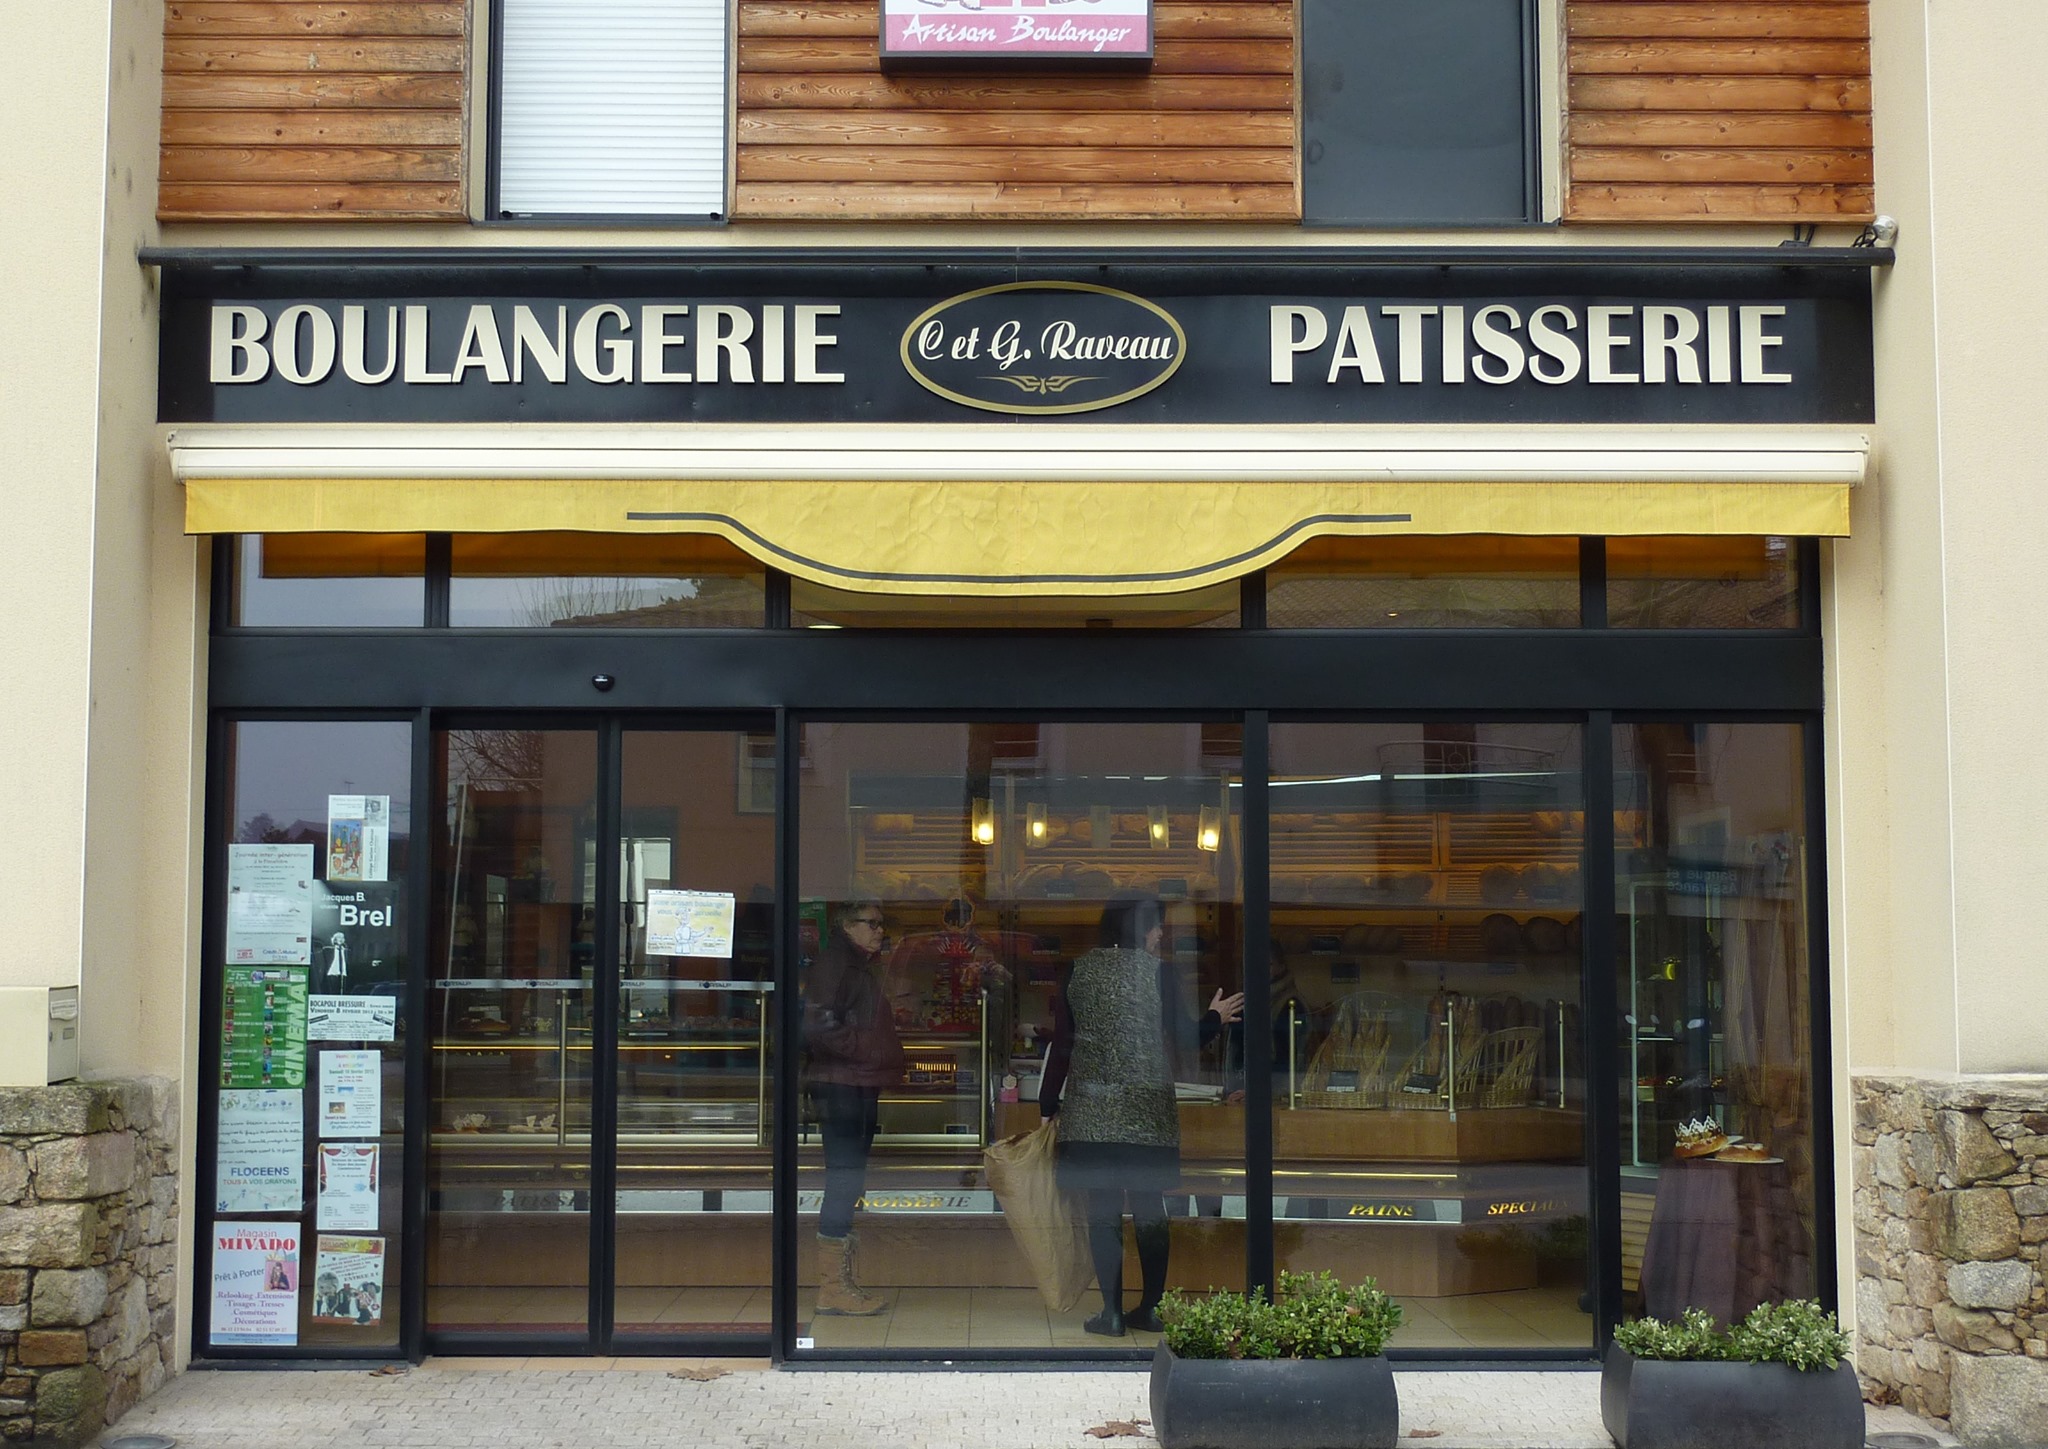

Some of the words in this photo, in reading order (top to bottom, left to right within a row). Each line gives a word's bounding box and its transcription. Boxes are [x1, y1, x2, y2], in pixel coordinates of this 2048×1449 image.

[902, 14, 996, 45] Artisan
[1000, 15, 1132, 52] Boulanger
[210, 303, 846, 385] BOULANGERIE
[951, 327, 980, 360] et
[987, 320, 1031, 371] G.
[1041, 320, 1173, 360] Raveau
[1269, 304, 1792, 385] PATISSERIE
[340, 904, 392, 926] Brel
[218, 1238, 296, 1251] MIVADO
[237, 1228, 277, 1238] Magasin
[240, 1268, 264, 1278] Porter
